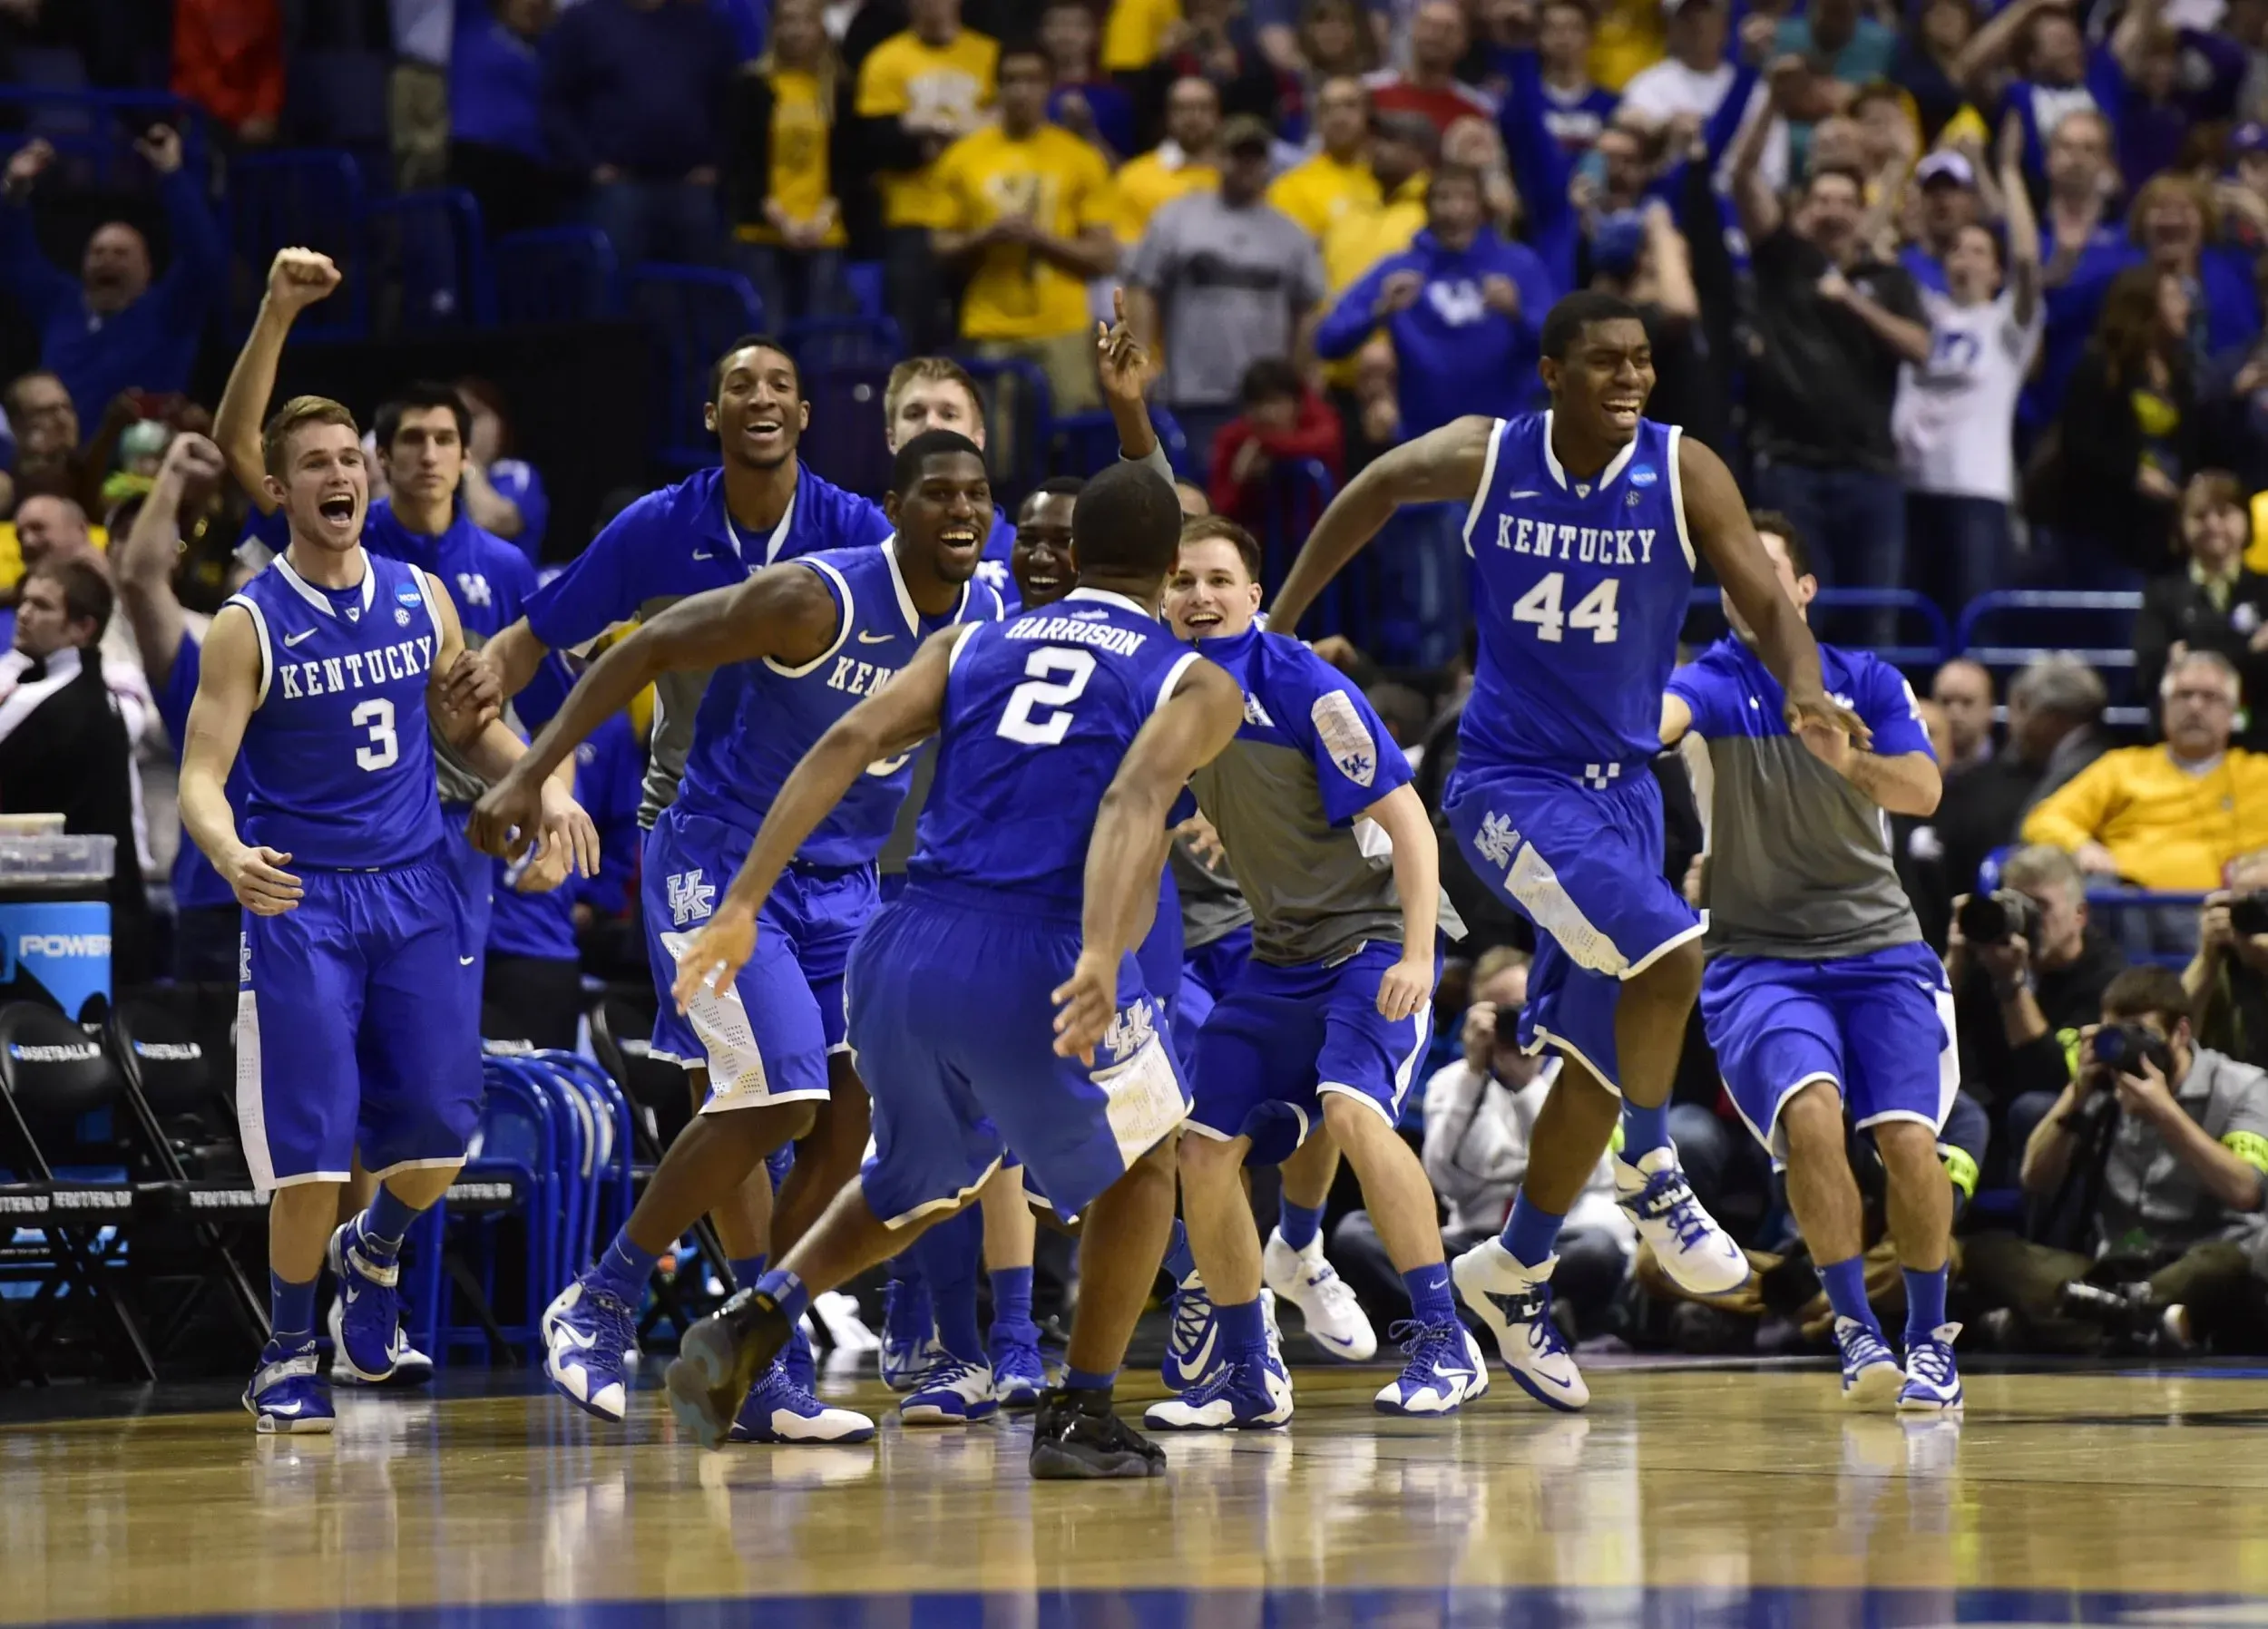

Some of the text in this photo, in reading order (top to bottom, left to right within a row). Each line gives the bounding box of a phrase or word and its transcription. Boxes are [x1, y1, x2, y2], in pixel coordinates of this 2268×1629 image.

[1496, 512, 1657, 564] KENTUCKY
[1004, 616, 1148, 658] HARRISON
[1512, 571, 1620, 643] 44
[279, 635, 432, 699] KENTUCKY
[826, 655, 898, 698] KEN
[995, 645, 1098, 746] 2
[351, 697, 399, 772] 3
[666, 868, 716, 926] UK
